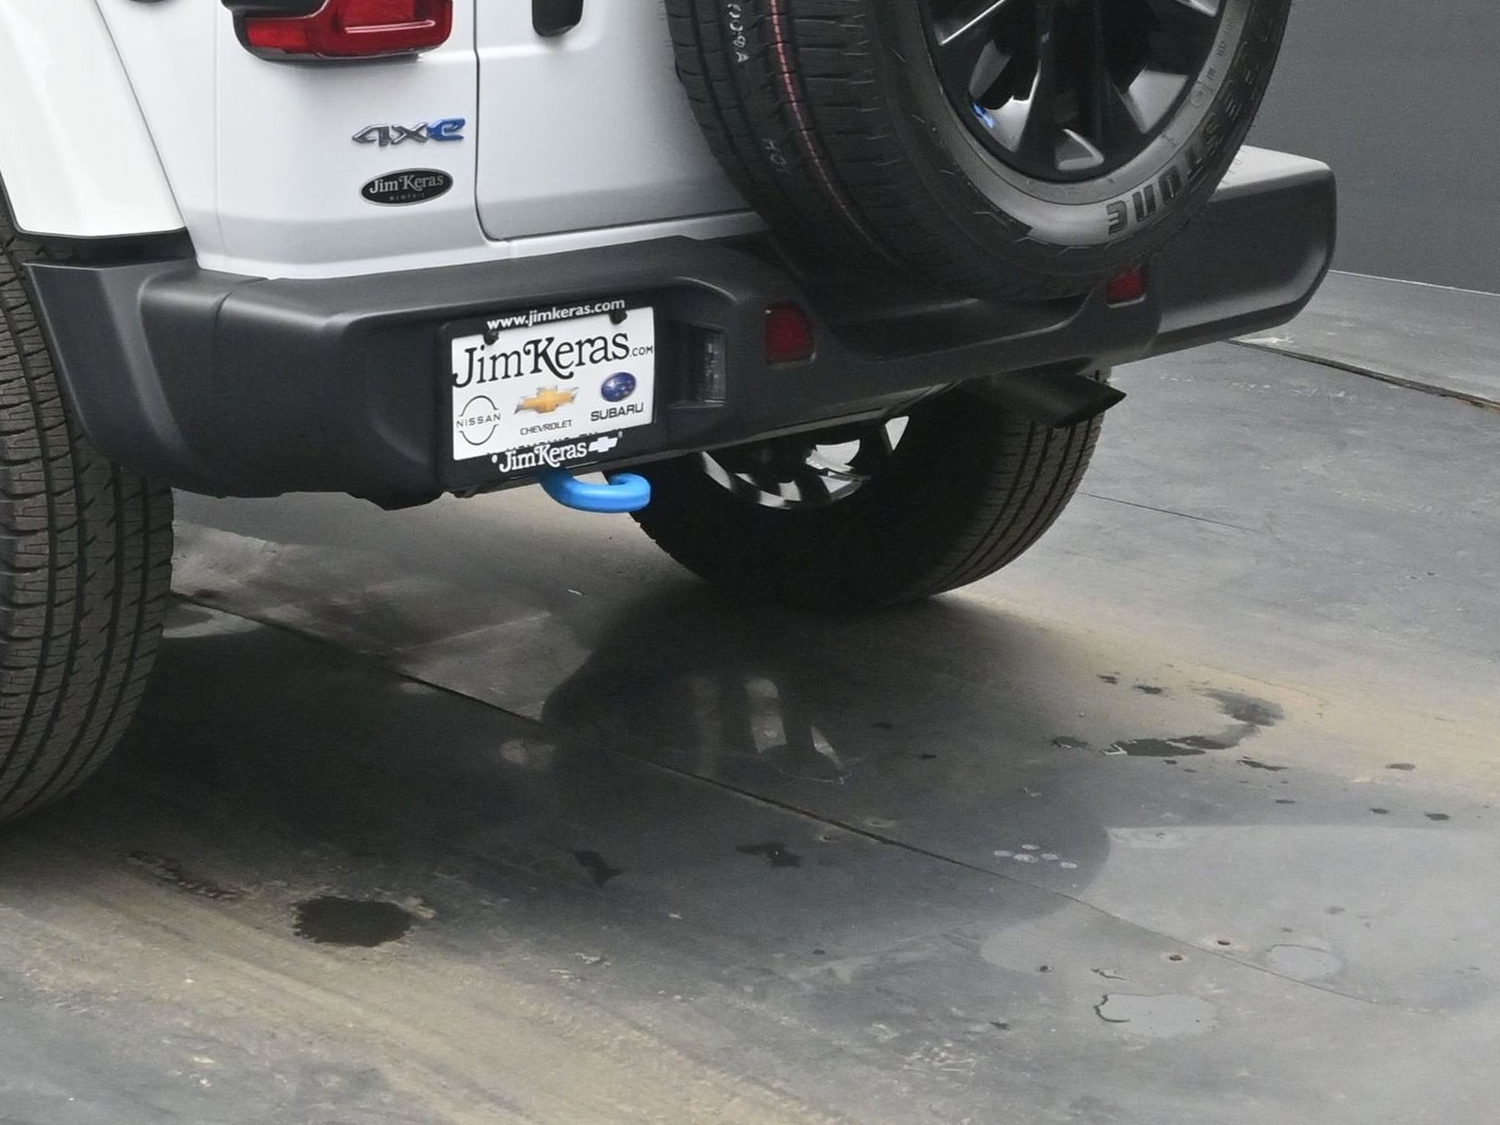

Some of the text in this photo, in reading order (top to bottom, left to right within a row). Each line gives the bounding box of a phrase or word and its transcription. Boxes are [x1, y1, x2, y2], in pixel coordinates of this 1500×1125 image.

[486, 300, 626, 330] www.jimkeras.com
[456, 413, 501, 428] NISSAN
[590, 403, 644, 422] SUBARU
[520, 419, 573, 436] CHEVROLET
